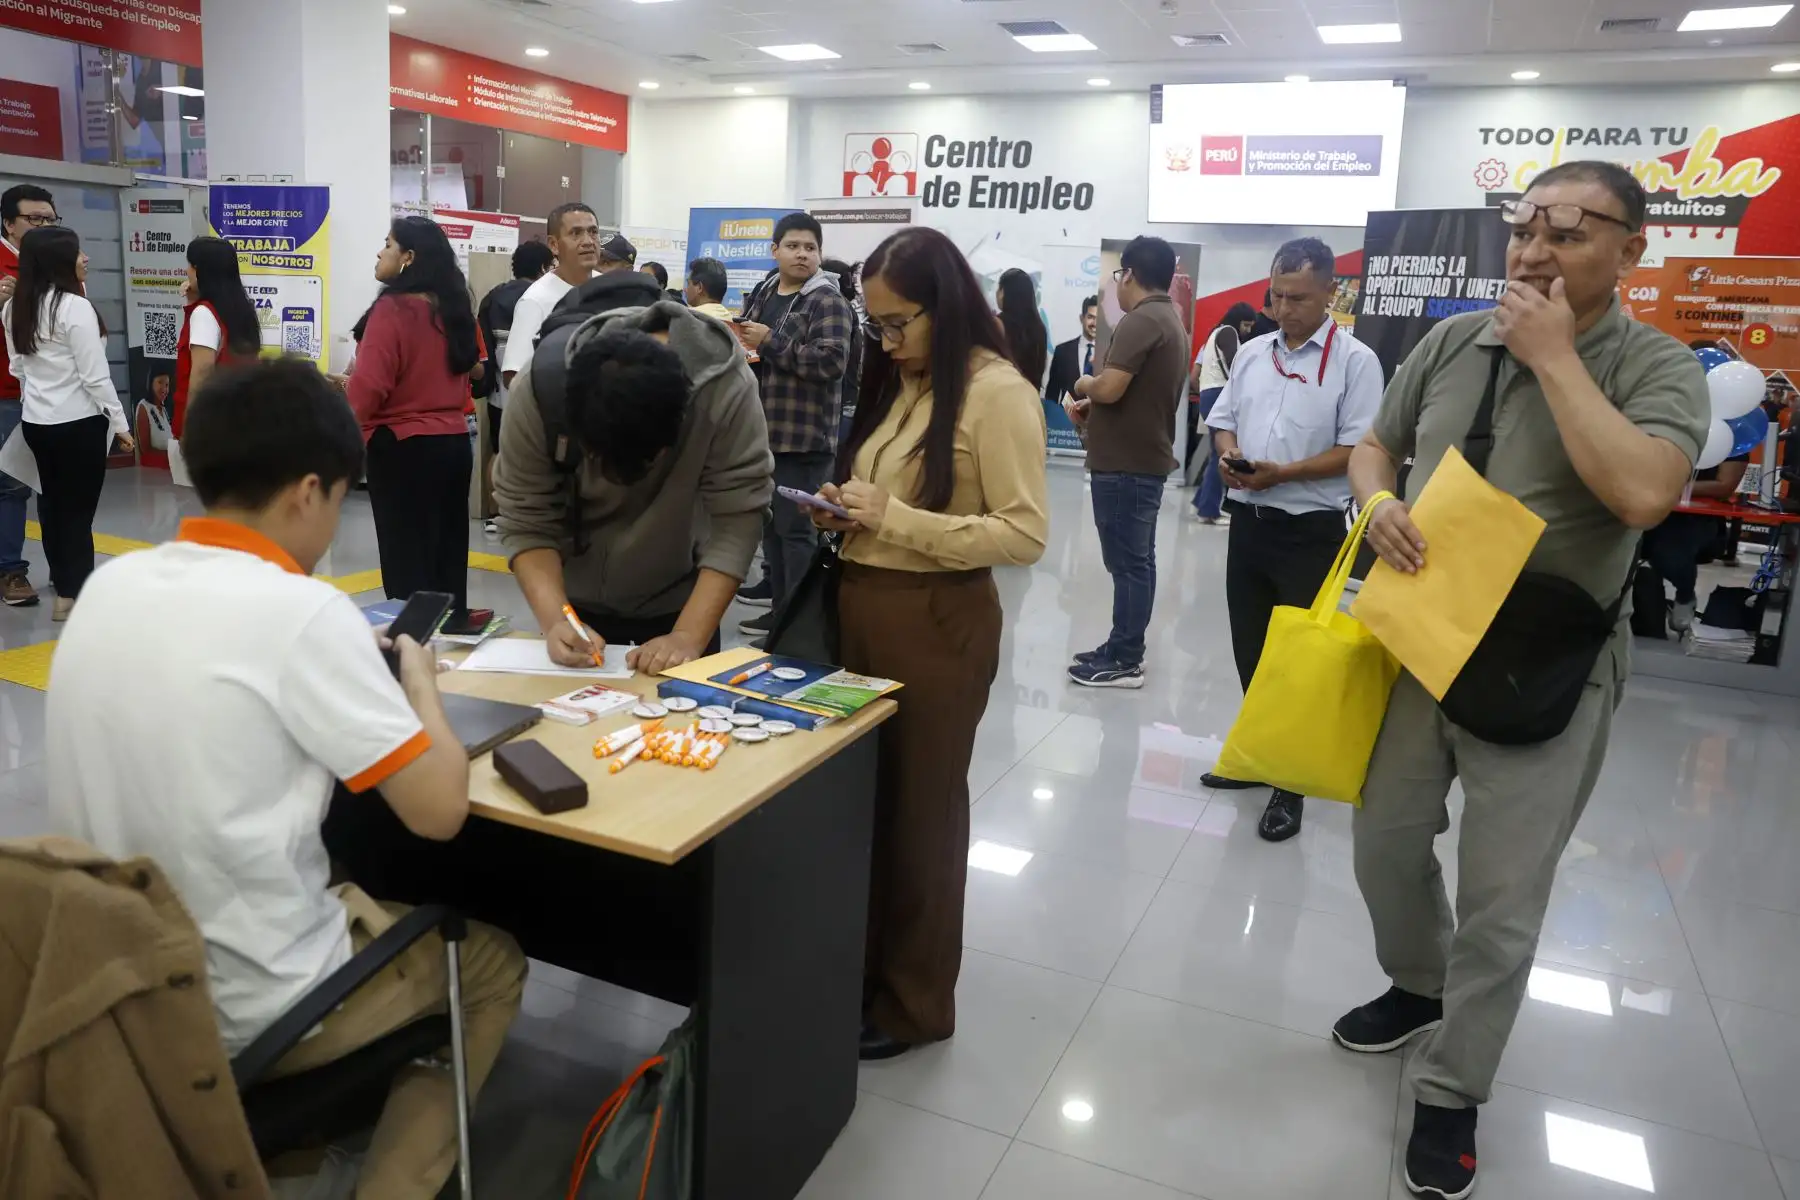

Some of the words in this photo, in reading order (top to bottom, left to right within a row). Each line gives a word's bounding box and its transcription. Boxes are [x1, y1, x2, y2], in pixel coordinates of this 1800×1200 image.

[146, 2, 166, 14] con
[36, 5, 48, 17] al
[50, 7, 103, 29] Migrante
[121, 9, 138, 23] del
[140, 14, 181, 33] Empleo
[473, 85, 496, 99] Módulo
[426, 92, 458, 107] Laborales
[473, 97, 509, 112] Orientación
[1478, 126, 1554, 146] TODO
[1566, 126, 1642, 146] PARA
[1650, 126, 1688, 146] TU
[924, 134, 1033, 169] Centro
[1205, 146, 1238, 163] PERÚ
[1249, 150, 1301, 162] Ministerio
[1302, 151, 1316, 162] de
[1319, 151, 1358, 164] Trabajo
[1248, 163, 1255, 173] y
[1256, 160, 1312, 172] Promoción
[1314, 161, 1330, 172] del
[1332, 161, 1373, 174] Empleo
[922, 174, 961, 208] de
[967, 174, 1095, 214] Empleo
[235, 210, 270, 218] MEJORES
[236, 218, 263, 226] MEJOR
[146, 230, 172, 242] Centro
[724, 222, 768, 237] ¡Únete
[147, 242, 156, 252] de
[157, 242, 186, 254] Empleo
[228, 239, 291, 251] TRABAJA
[704, 246, 712, 258] a
[718, 244, 768, 258] Nestlé!
[252, 256, 312, 268] NOSOTROS
[1390, 256, 1447, 276] PIERDAS
[1448, 256, 1467, 277] LA
[130, 266, 157, 276] Reserva
[1709, 274, 1735, 285] Little
[1736, 275, 1775, 287] Caesars
[1366, 276, 1452, 298] OPORTUNIDAD
[1455, 278, 1466, 298] Y
[1466, 278, 1508, 300] UNET
[1674, 295, 1716, 304] FRANQUICIA
[1716, 296, 1770, 304] AMERICANA
[1362, 296, 1377, 315] AL
[1378, 297, 1424, 318] EQUIPO
[1706, 303, 1724, 311] CON
[1675, 310, 1683, 320] 5
[1750, 328, 1767, 345] 8
